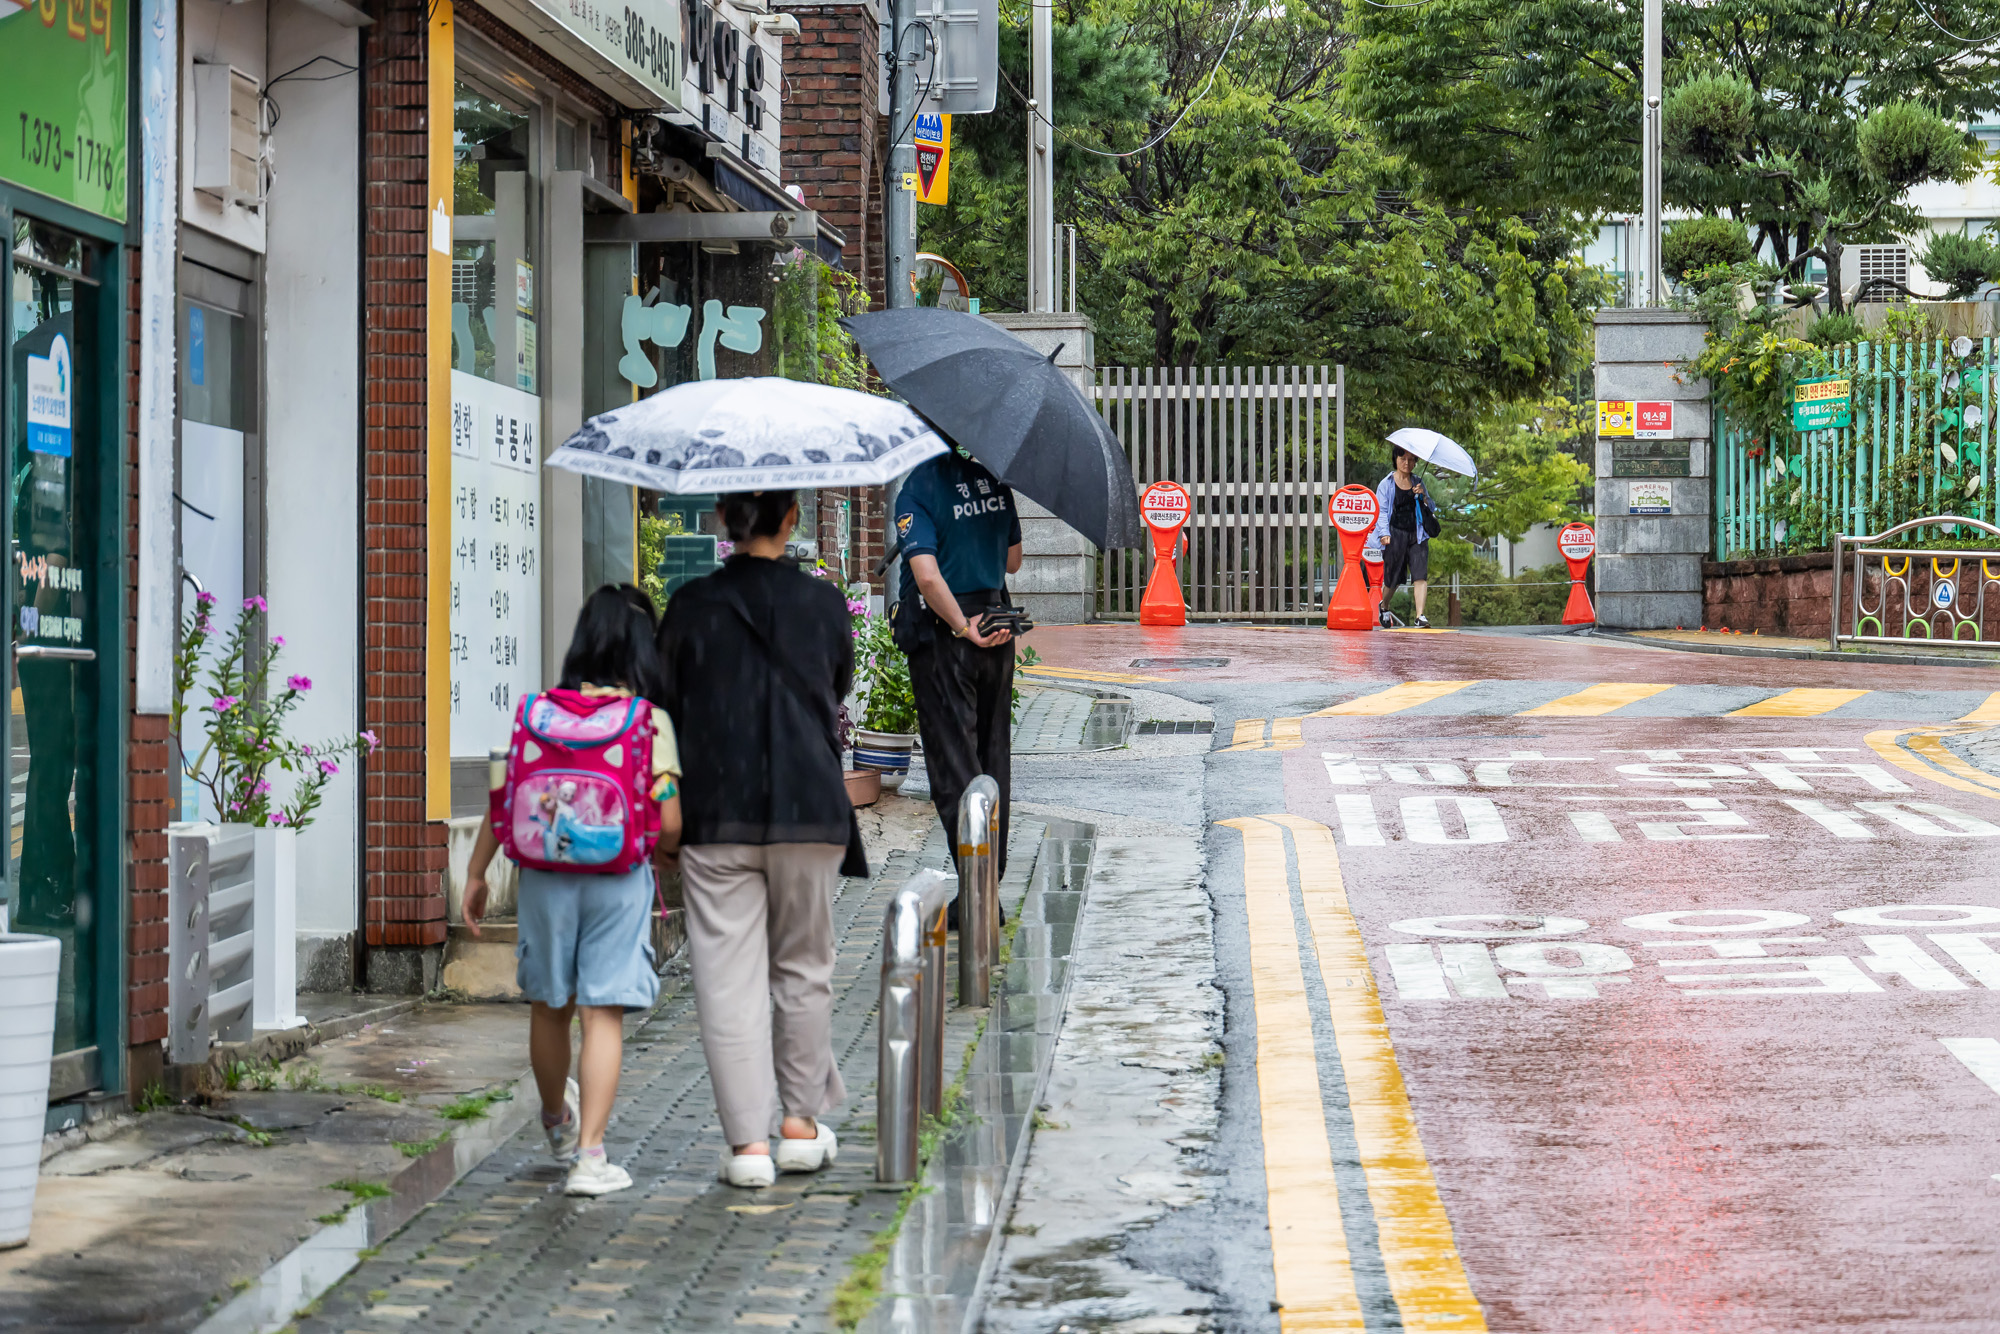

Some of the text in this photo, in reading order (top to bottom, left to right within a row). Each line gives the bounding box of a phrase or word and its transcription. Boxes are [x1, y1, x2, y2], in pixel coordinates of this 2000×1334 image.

[624, 5, 676, 91] 386-8497
[917, 127, 941, 140] 어린이보호
[19, 111, 113, 191] T.373-1716
[920, 152, 937, 165] 천천히
[1810, 385, 1819, 399] 안전
[453, 402, 472, 450] 철학
[1642, 411, 1667, 422] 에스원
[495, 413, 533, 465] 부동산
[460, 486, 477, 520] 궁합
[956, 479, 991, 499] 경찰
[1148, 495, 1183, 508] 주차금지
[1336, 498, 1372, 511] 주차금지
[495, 496, 535, 532] 토지 가옥
[953, 496, 1006, 520] POLICE
[1150, 512, 1181, 521] 서울연신초등학교
[1338, 515, 1370, 525] 서울연신초등학교
[1564, 533, 1592, 543] 주차금지
[460, 536, 476, 572] 수맥
[495, 541, 535, 577] 빌라 상가
[495, 589, 509, 620] 임야
[495, 681, 509, 712] 매매
[1321, 747, 1916, 794] 보호구역
[1333, 793, 2000, 848] 어린이
